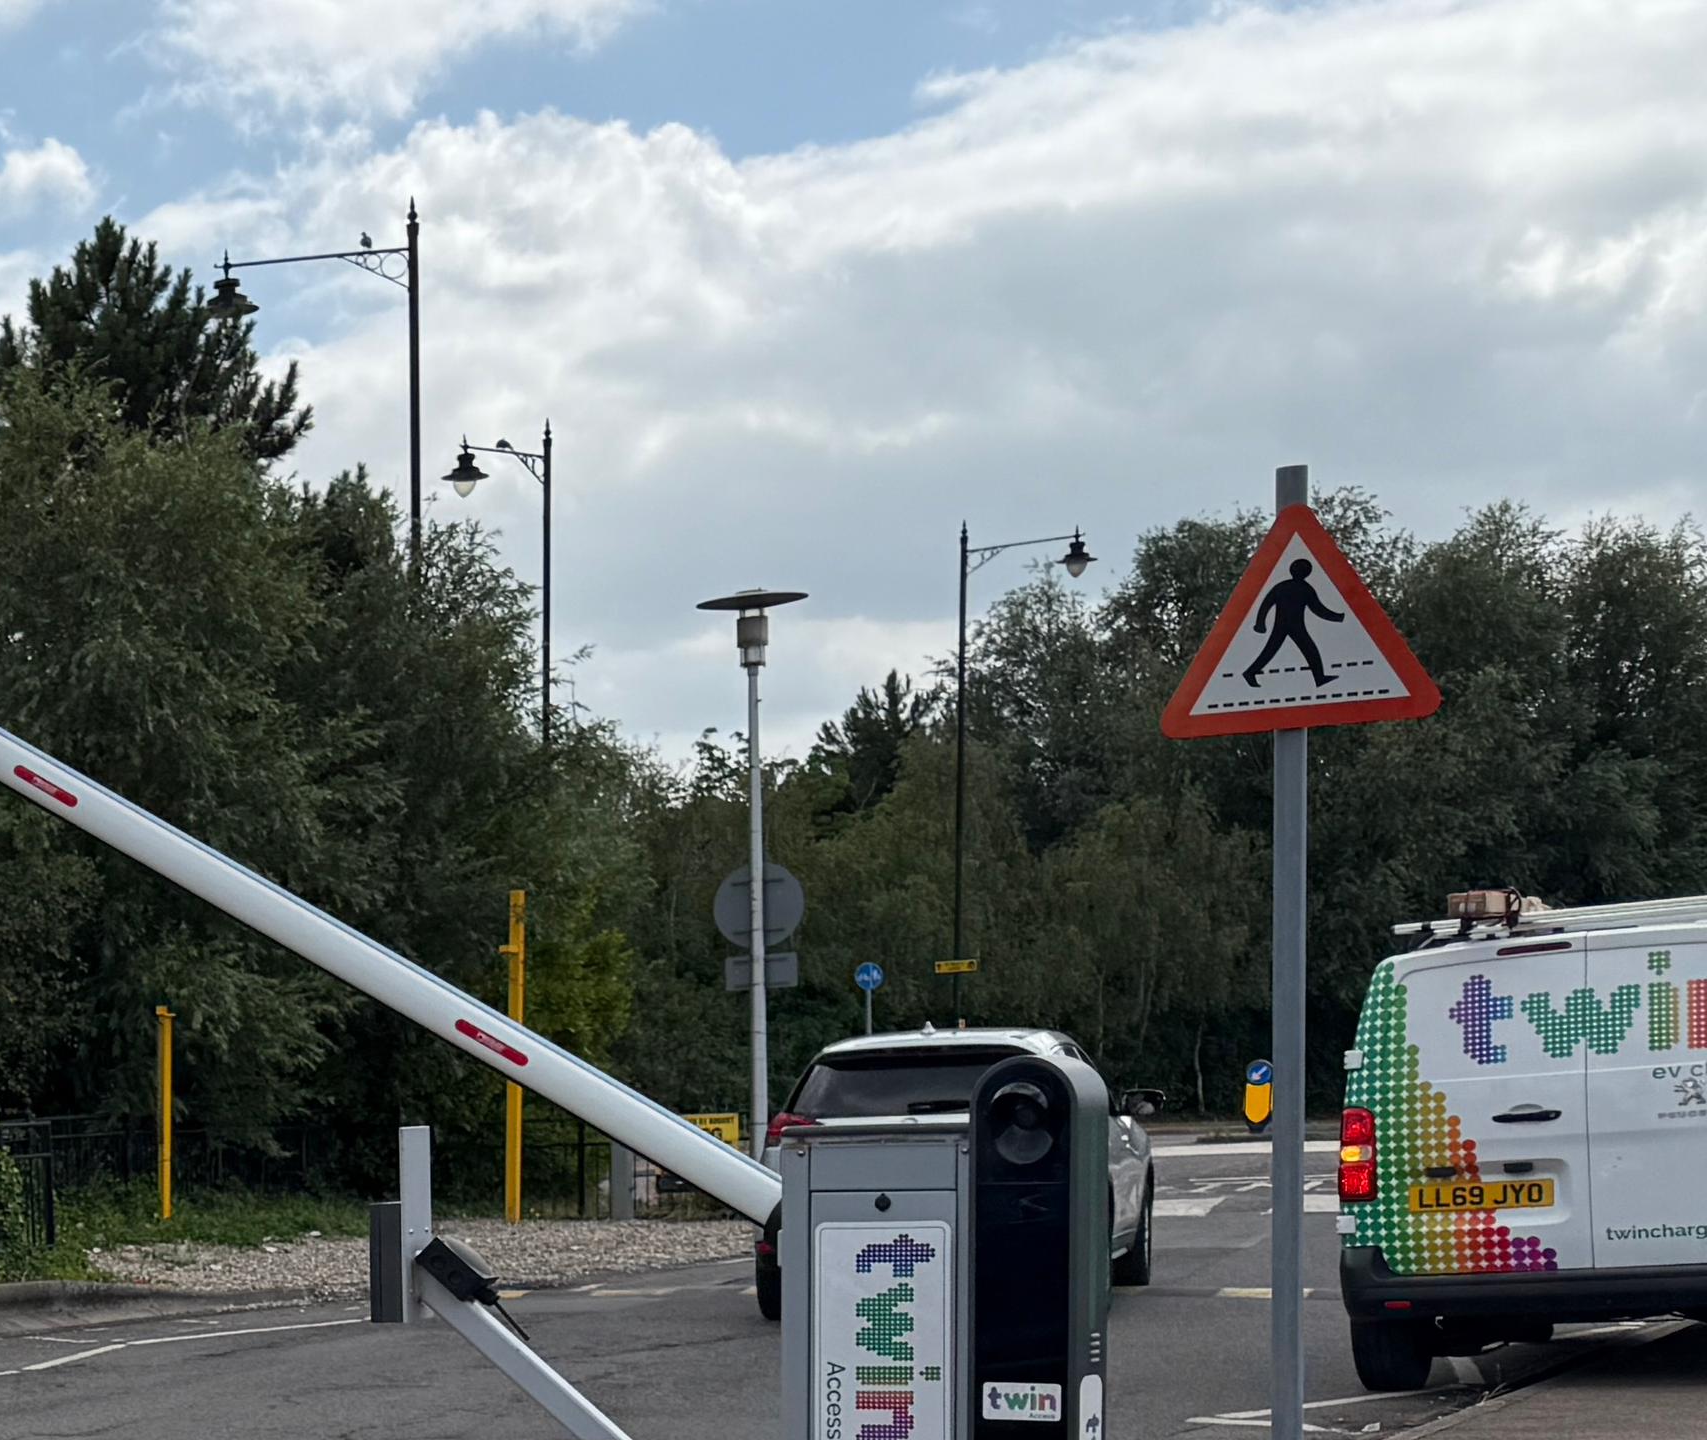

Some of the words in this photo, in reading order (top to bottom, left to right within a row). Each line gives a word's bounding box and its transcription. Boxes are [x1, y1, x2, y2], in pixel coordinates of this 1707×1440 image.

[1652, 1066, 1682, 1079] ev
[1690, 1061, 1707, 1077] c
[1419, 1185, 1484, 1209] LL69
[1494, 1182, 1544, 1205] JYO
[1605, 1223, 1707, 1240] twincharg
[827, 1361, 846, 1440] Access
[987, 1386, 1057, 1412] twin
